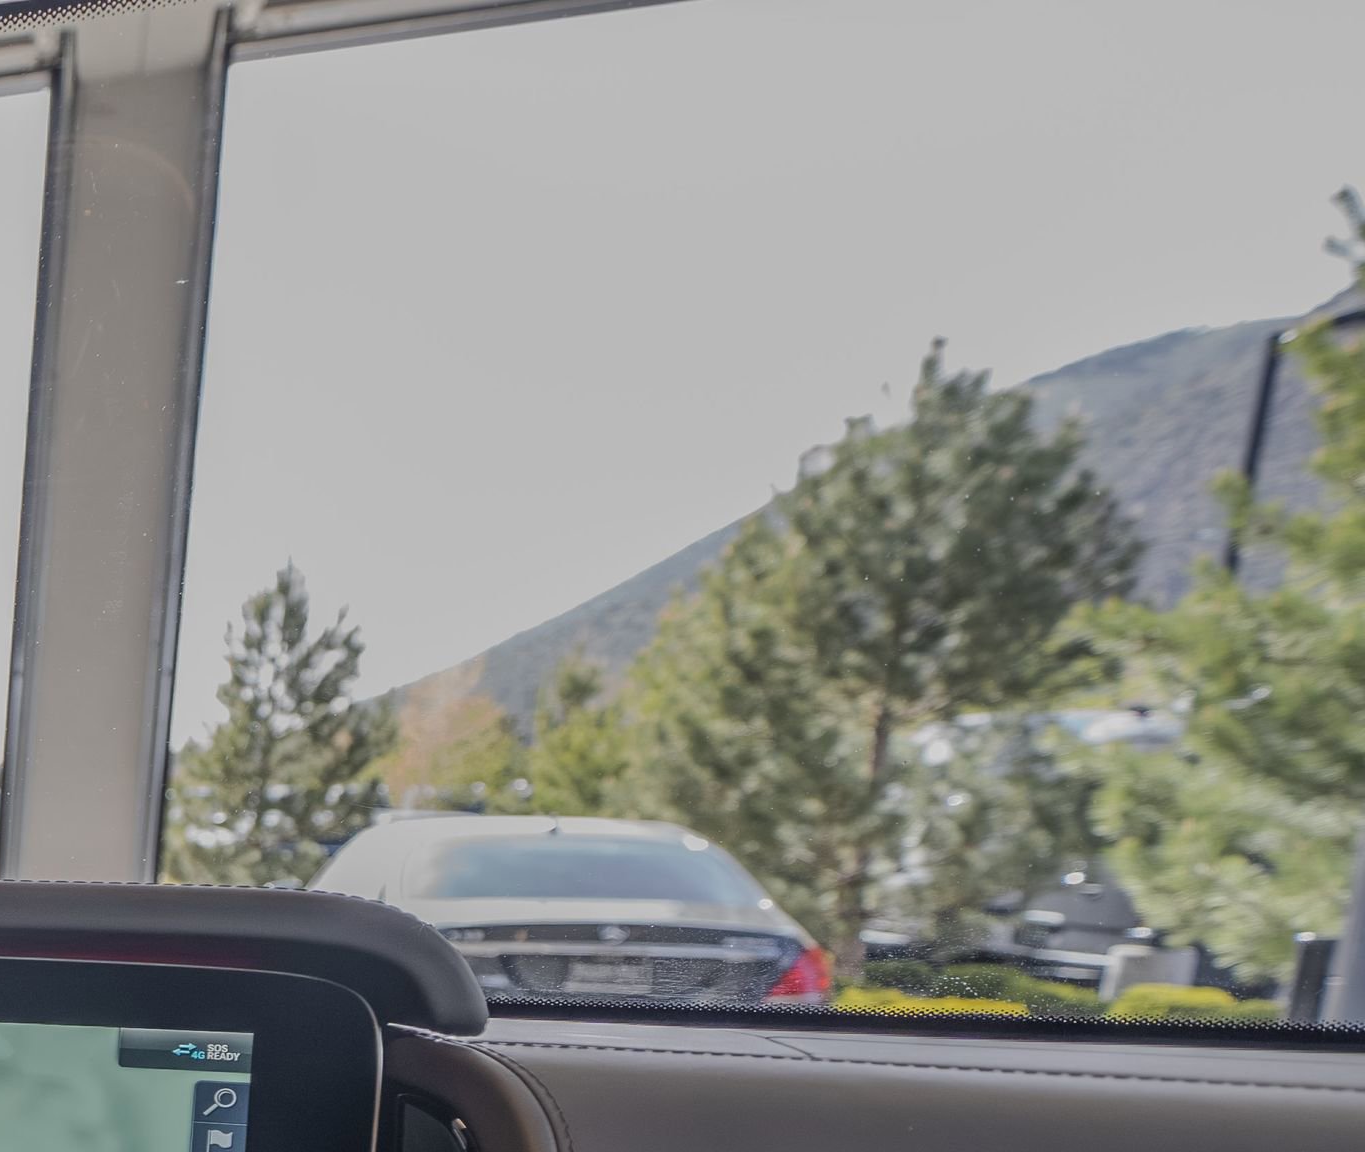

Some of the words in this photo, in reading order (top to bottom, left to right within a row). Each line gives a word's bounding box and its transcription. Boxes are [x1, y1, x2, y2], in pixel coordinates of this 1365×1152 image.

[206, 1042, 229, 1054] SOS
[190, 1049, 206, 1060] 4G
[206, 1050, 241, 1062] READY
